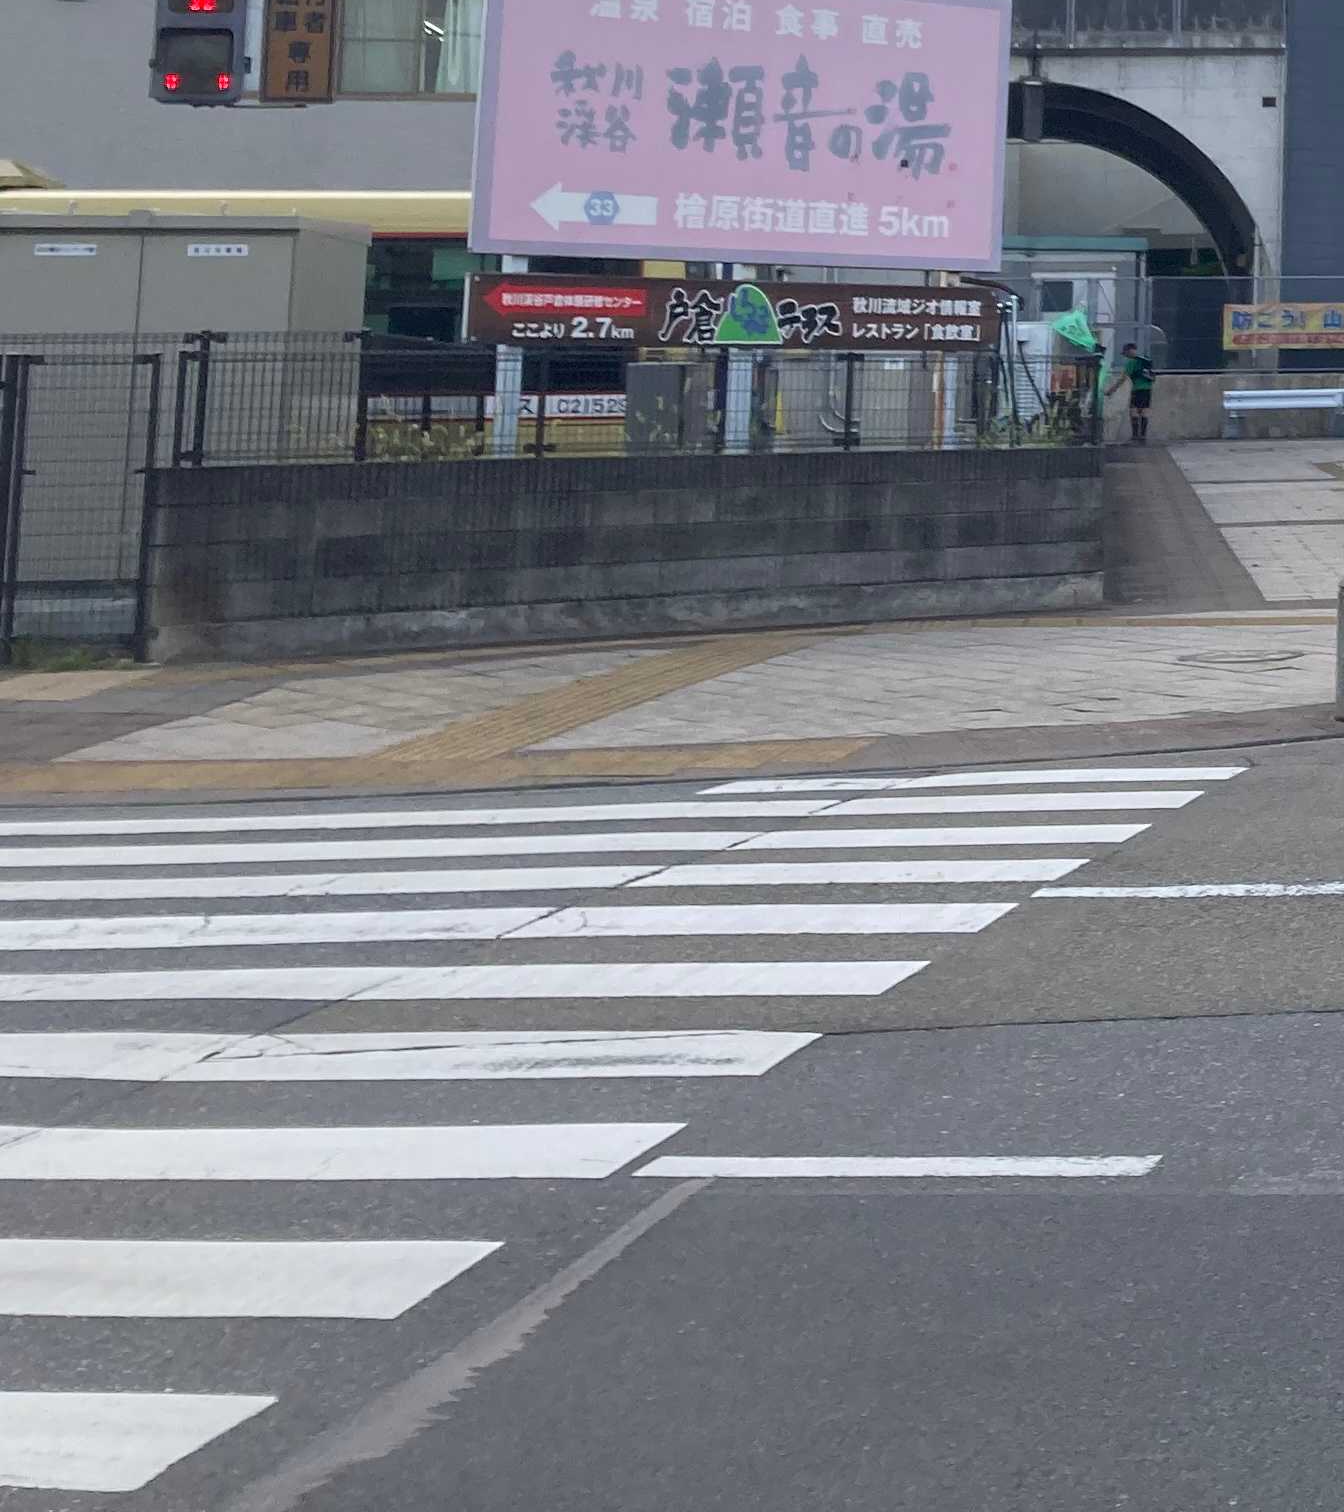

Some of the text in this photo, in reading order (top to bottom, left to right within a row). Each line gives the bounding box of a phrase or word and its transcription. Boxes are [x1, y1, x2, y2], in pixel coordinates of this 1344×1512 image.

[775, 3, 839, 41] 食事
[861, 14, 923, 49] 直売
[550, 50, 644, 102] 秋川
[555, 99, 638, 155] 渓谷
[665, 53, 952, 181] 瀬音の湯
[588, 197, 614, 217] 33
[672, 191, 951, 239] 檜原街道直進 5km
[511, 316, 635, 339] ここより 2.7km
